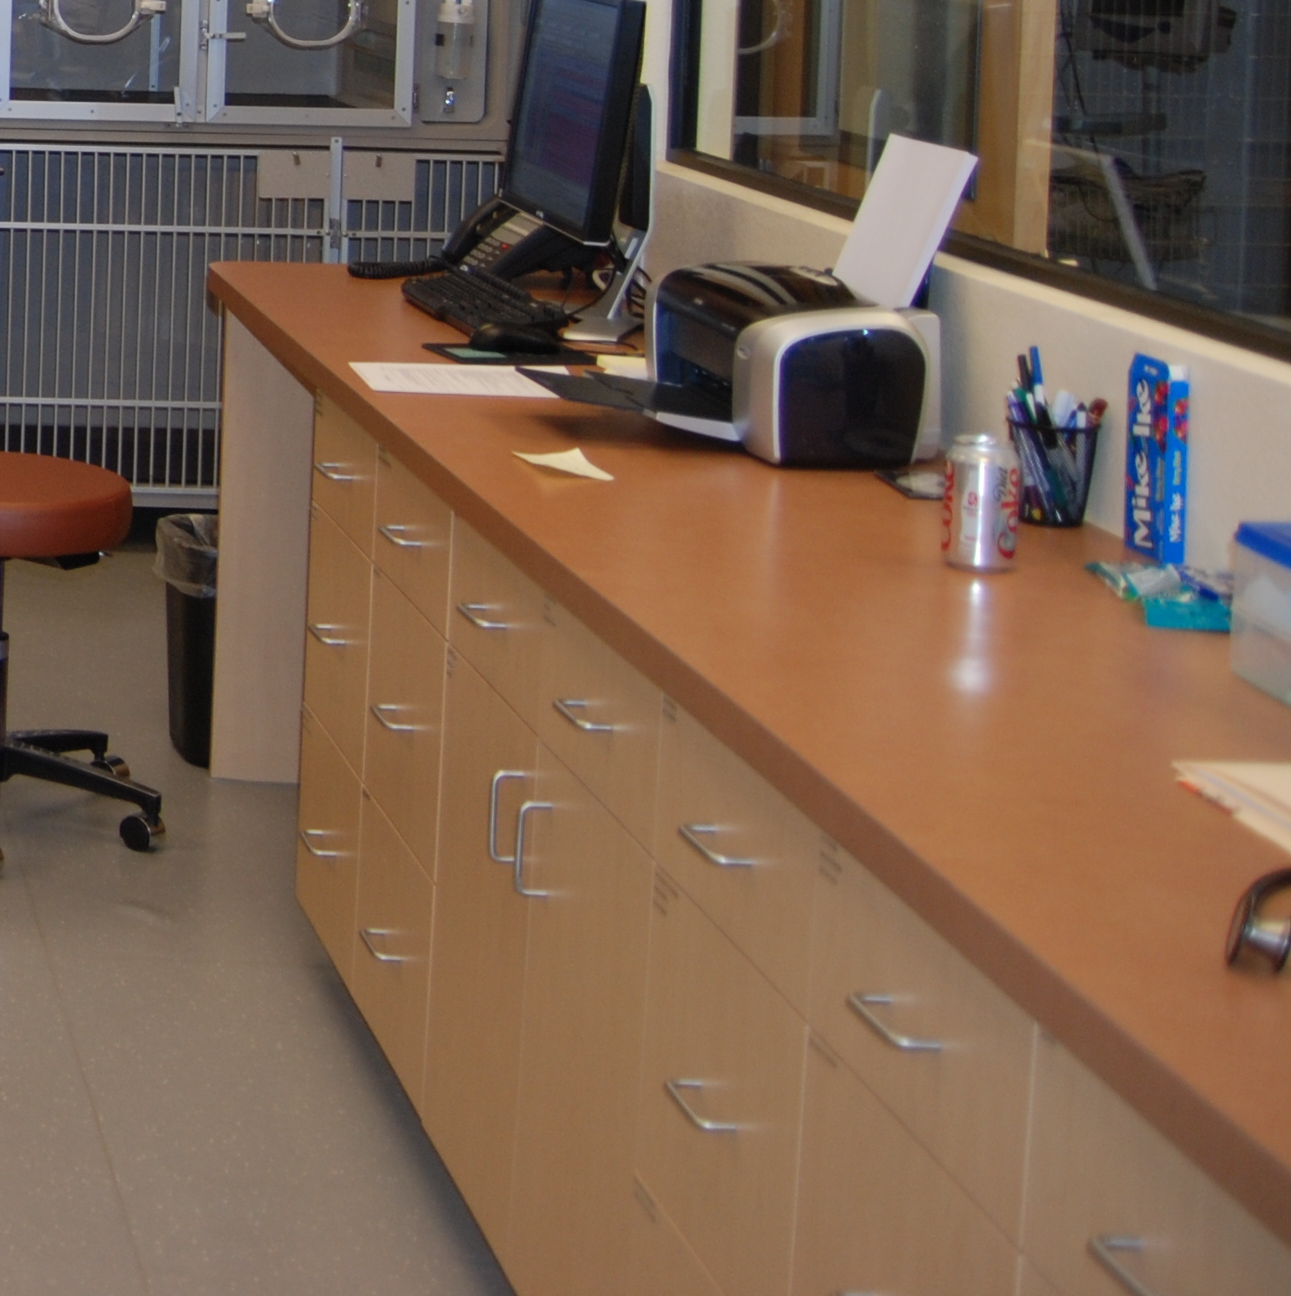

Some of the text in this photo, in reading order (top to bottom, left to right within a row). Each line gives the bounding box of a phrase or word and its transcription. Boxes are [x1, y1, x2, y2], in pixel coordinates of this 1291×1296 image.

[1133, 379, 1152, 438] Ike
[997, 468, 1019, 560] Coke
[1132, 451, 1153, 548] Mike
